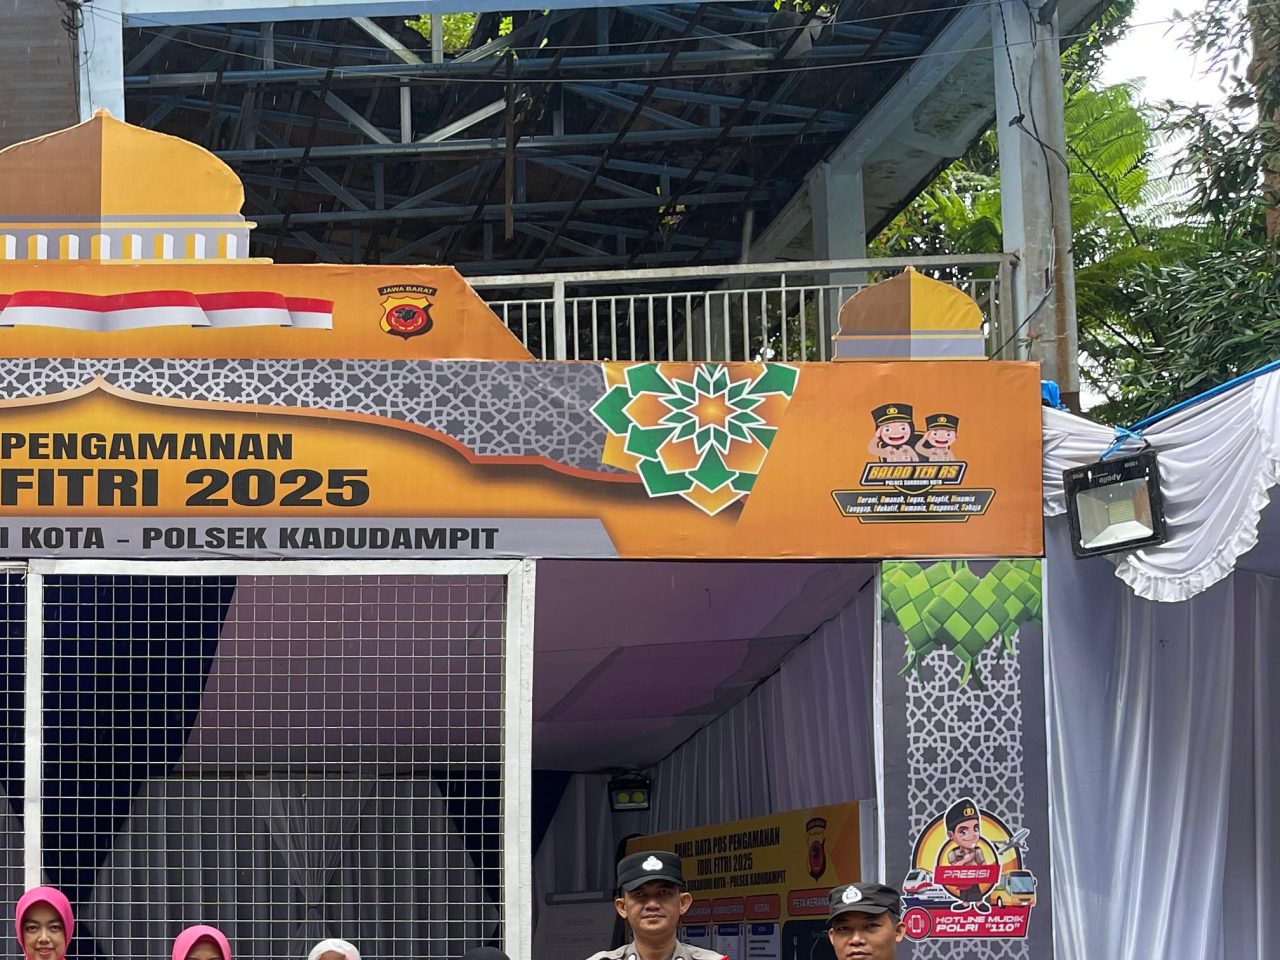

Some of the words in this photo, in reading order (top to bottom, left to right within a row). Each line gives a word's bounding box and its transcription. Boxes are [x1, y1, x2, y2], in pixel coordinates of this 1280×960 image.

[382, 286, 404, 294] JAWA
[406, 286, 434, 295] BARAT
[0, 432, 293, 461] PENGAMANAN
[1, 468, 159, 507] FITRI
[185, 468, 370, 507] 2025
[22, 526, 105, 549] KOTA
[142, 527, 268, 550] POLSEK
[279, 527, 500, 551] KADUDAMPIT
[695, 837, 712, 857] DATA
[713, 835, 728, 854] POS
[729, 826, 780, 852] PENGAMANAN
[697, 857, 713, 877] IDUL
[714, 855, 732, 874] FITRI
[733, 852, 753, 872] 2025
[943, 869, 990, 879] PRESISI
[936, 916, 985, 924] HOTLINE
[988, 915, 1024, 923] MUDIK
[936, 924, 978, 932] POLRI
